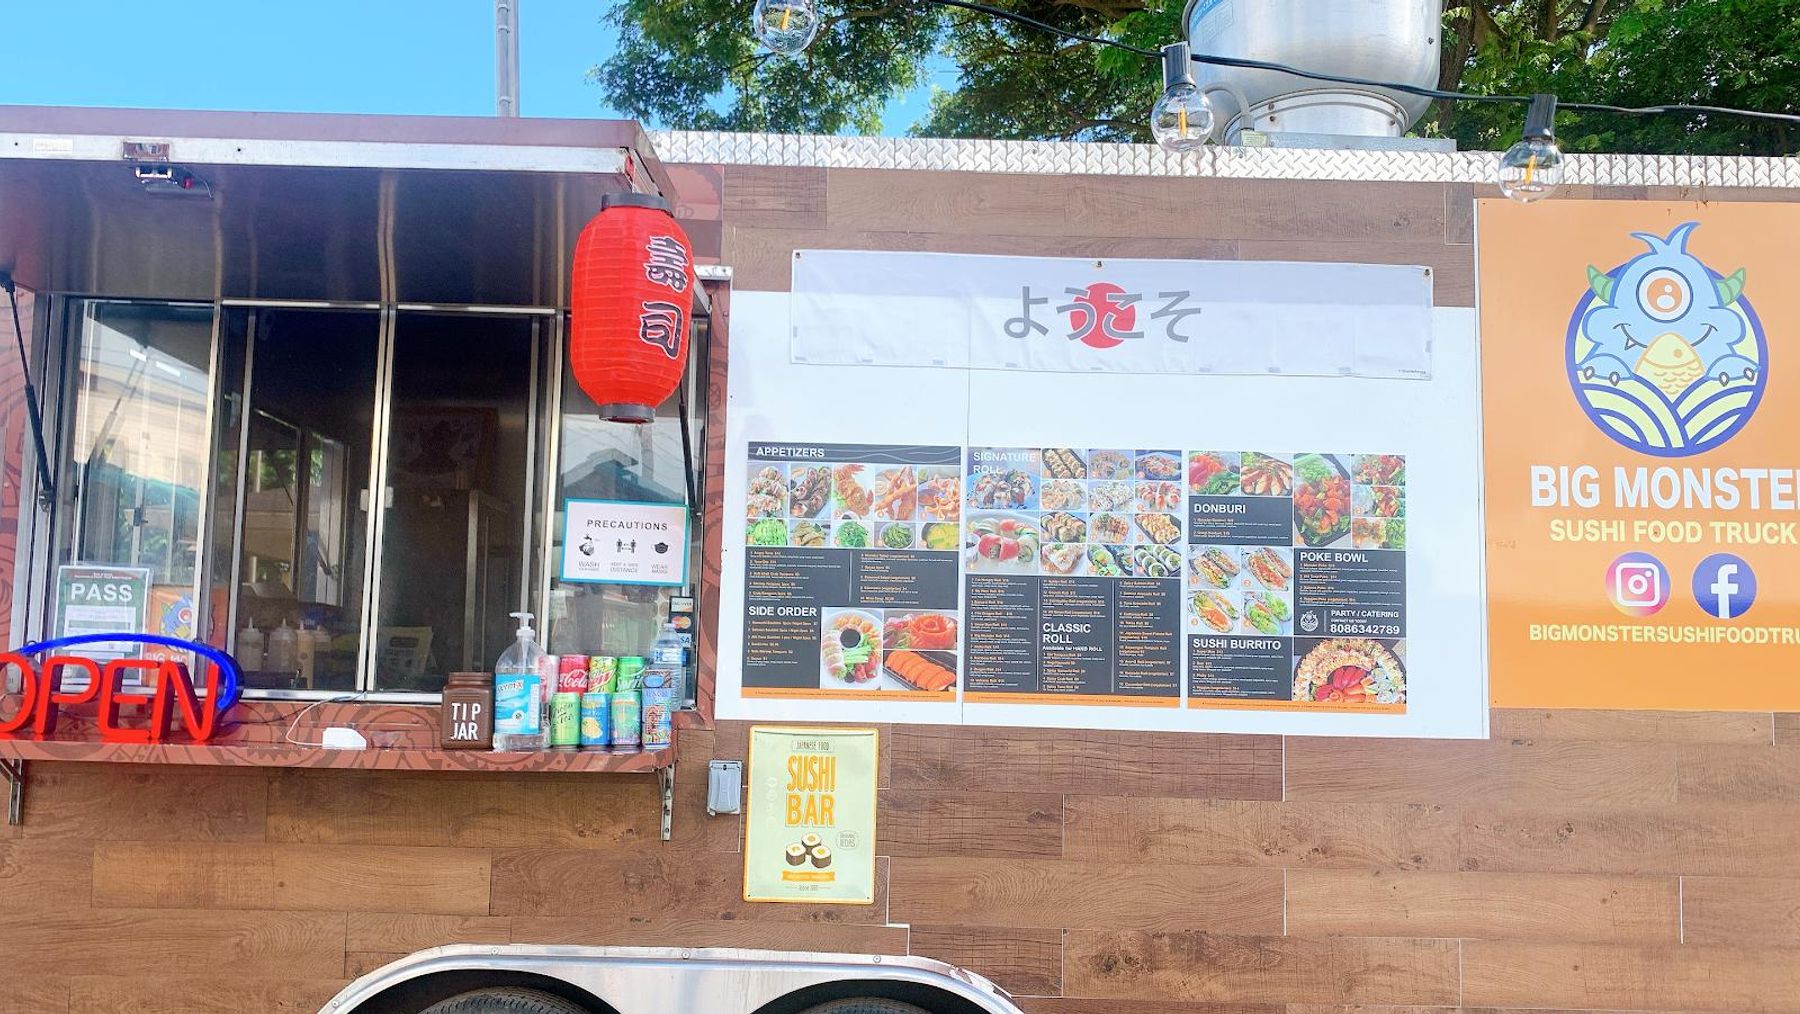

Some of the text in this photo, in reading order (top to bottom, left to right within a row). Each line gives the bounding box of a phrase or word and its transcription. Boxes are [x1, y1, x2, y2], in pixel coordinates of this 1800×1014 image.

[1002, 284, 1202, 343] ようこそ
[755, 446, 825, 458] APPETIZERS
[973, 450, 1037, 463] SIGNATURE
[973, 464, 1003, 475] ROLL
[1530, 465, 1800, 510] BIG MONSTE
[1193, 503, 1246, 514] DONBURI
[586, 518, 669, 531] PRECAUTIONS
[1550, 519, 1798, 545] SUSHI FOOD TRUCK
[1300, 552, 1368, 563] POKE BOWL
[71, 582, 133, 602] PASS
[748, 606, 817, 617] SIDE ORDER
[1331, 610, 1355, 618] PARTY
[1362, 610, 1399, 618] CATERING
[1043, 622, 1091, 633] CLASSIC
[1330, 623, 1400, 635] 8086342789
[1043, 634, 1073, 643] ROLL
[1193, 638, 1281, 650] SUSHI BURRITO
[0, 652, 219, 741] OPEN
[452, 703, 481, 721] TIP
[450, 722, 478, 741] JAR
[786, 754, 837, 793] SUSHI
[786, 793, 835, 827] BAR
